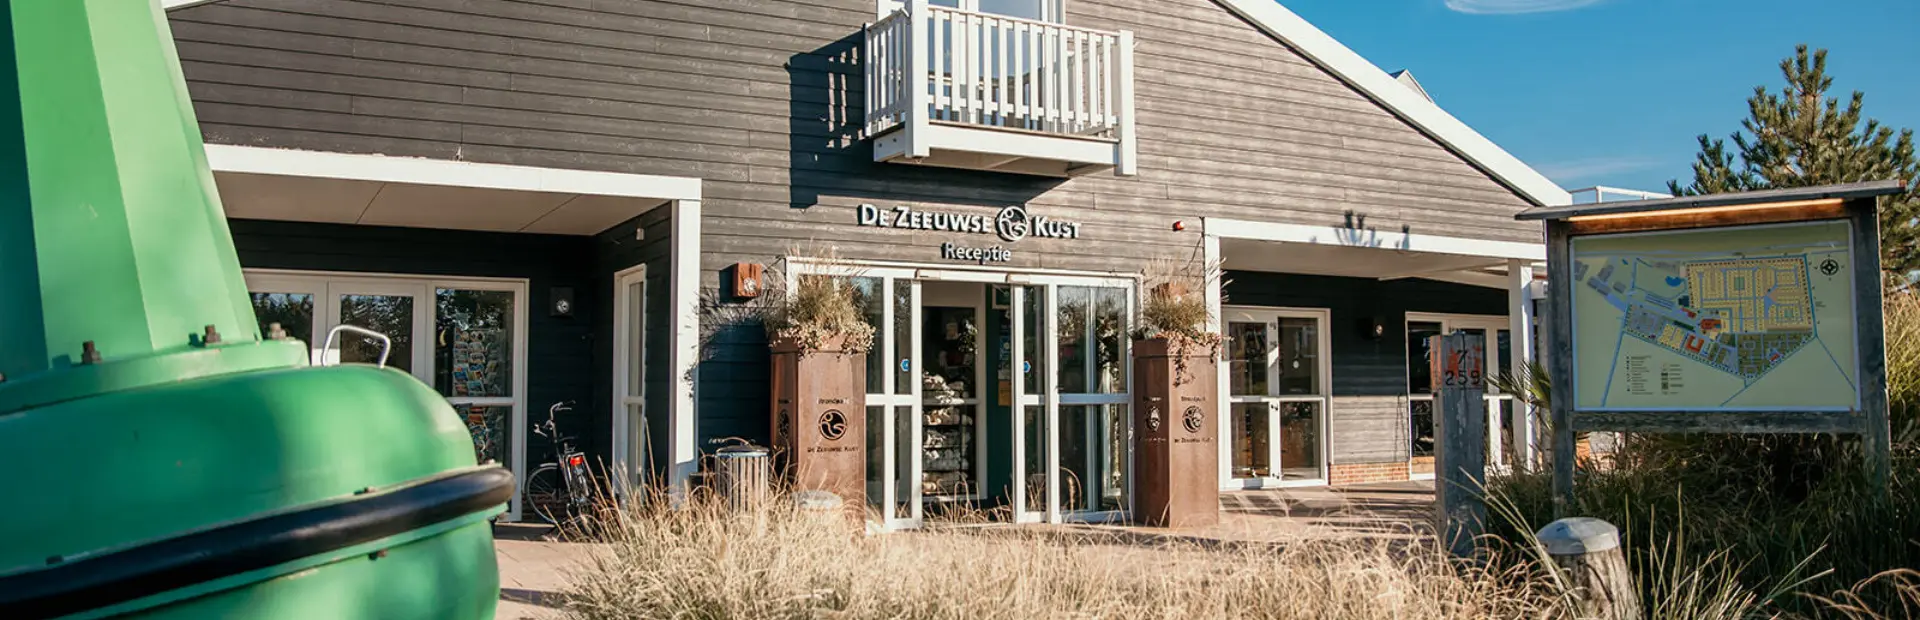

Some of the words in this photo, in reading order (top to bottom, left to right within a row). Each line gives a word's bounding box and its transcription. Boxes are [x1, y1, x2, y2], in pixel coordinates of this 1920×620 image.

[895, 205, 992, 233] ZEEUWSE
[1032, 215, 1082, 238] KUST
[943, 241, 1012, 264] Receptie
[1445, 370, 1481, 386] 259
